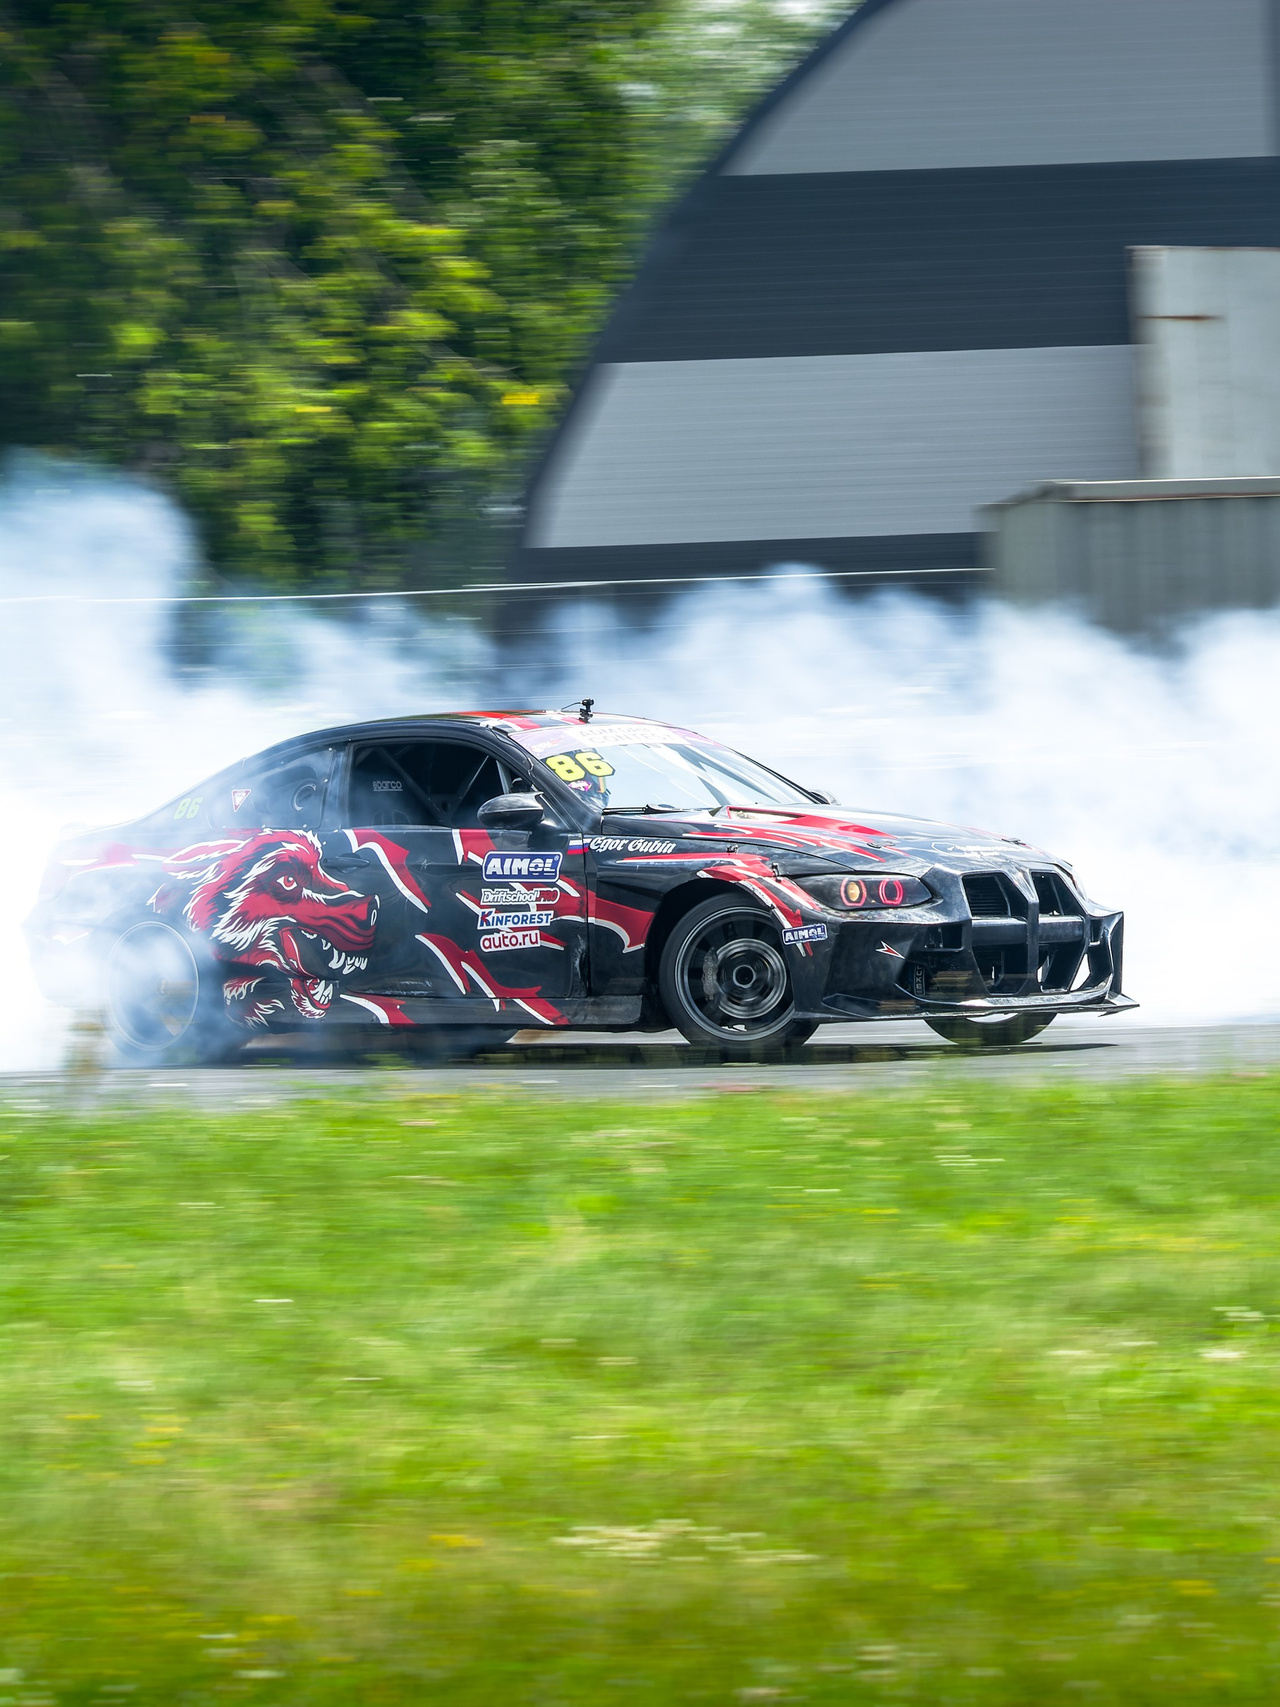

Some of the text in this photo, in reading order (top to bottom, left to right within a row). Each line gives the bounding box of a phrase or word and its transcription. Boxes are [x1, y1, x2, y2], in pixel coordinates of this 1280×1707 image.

[545, 752, 616, 782] 86
[173, 797, 203, 820] 86
[589, 836, 677, 853] Egor Gubin
[486, 858, 556, 876] AIMOL
[479, 910, 552, 927] KINFOREST
[482, 932, 539, 949] auto.ru
[785, 927, 826, 941] AIMOL
